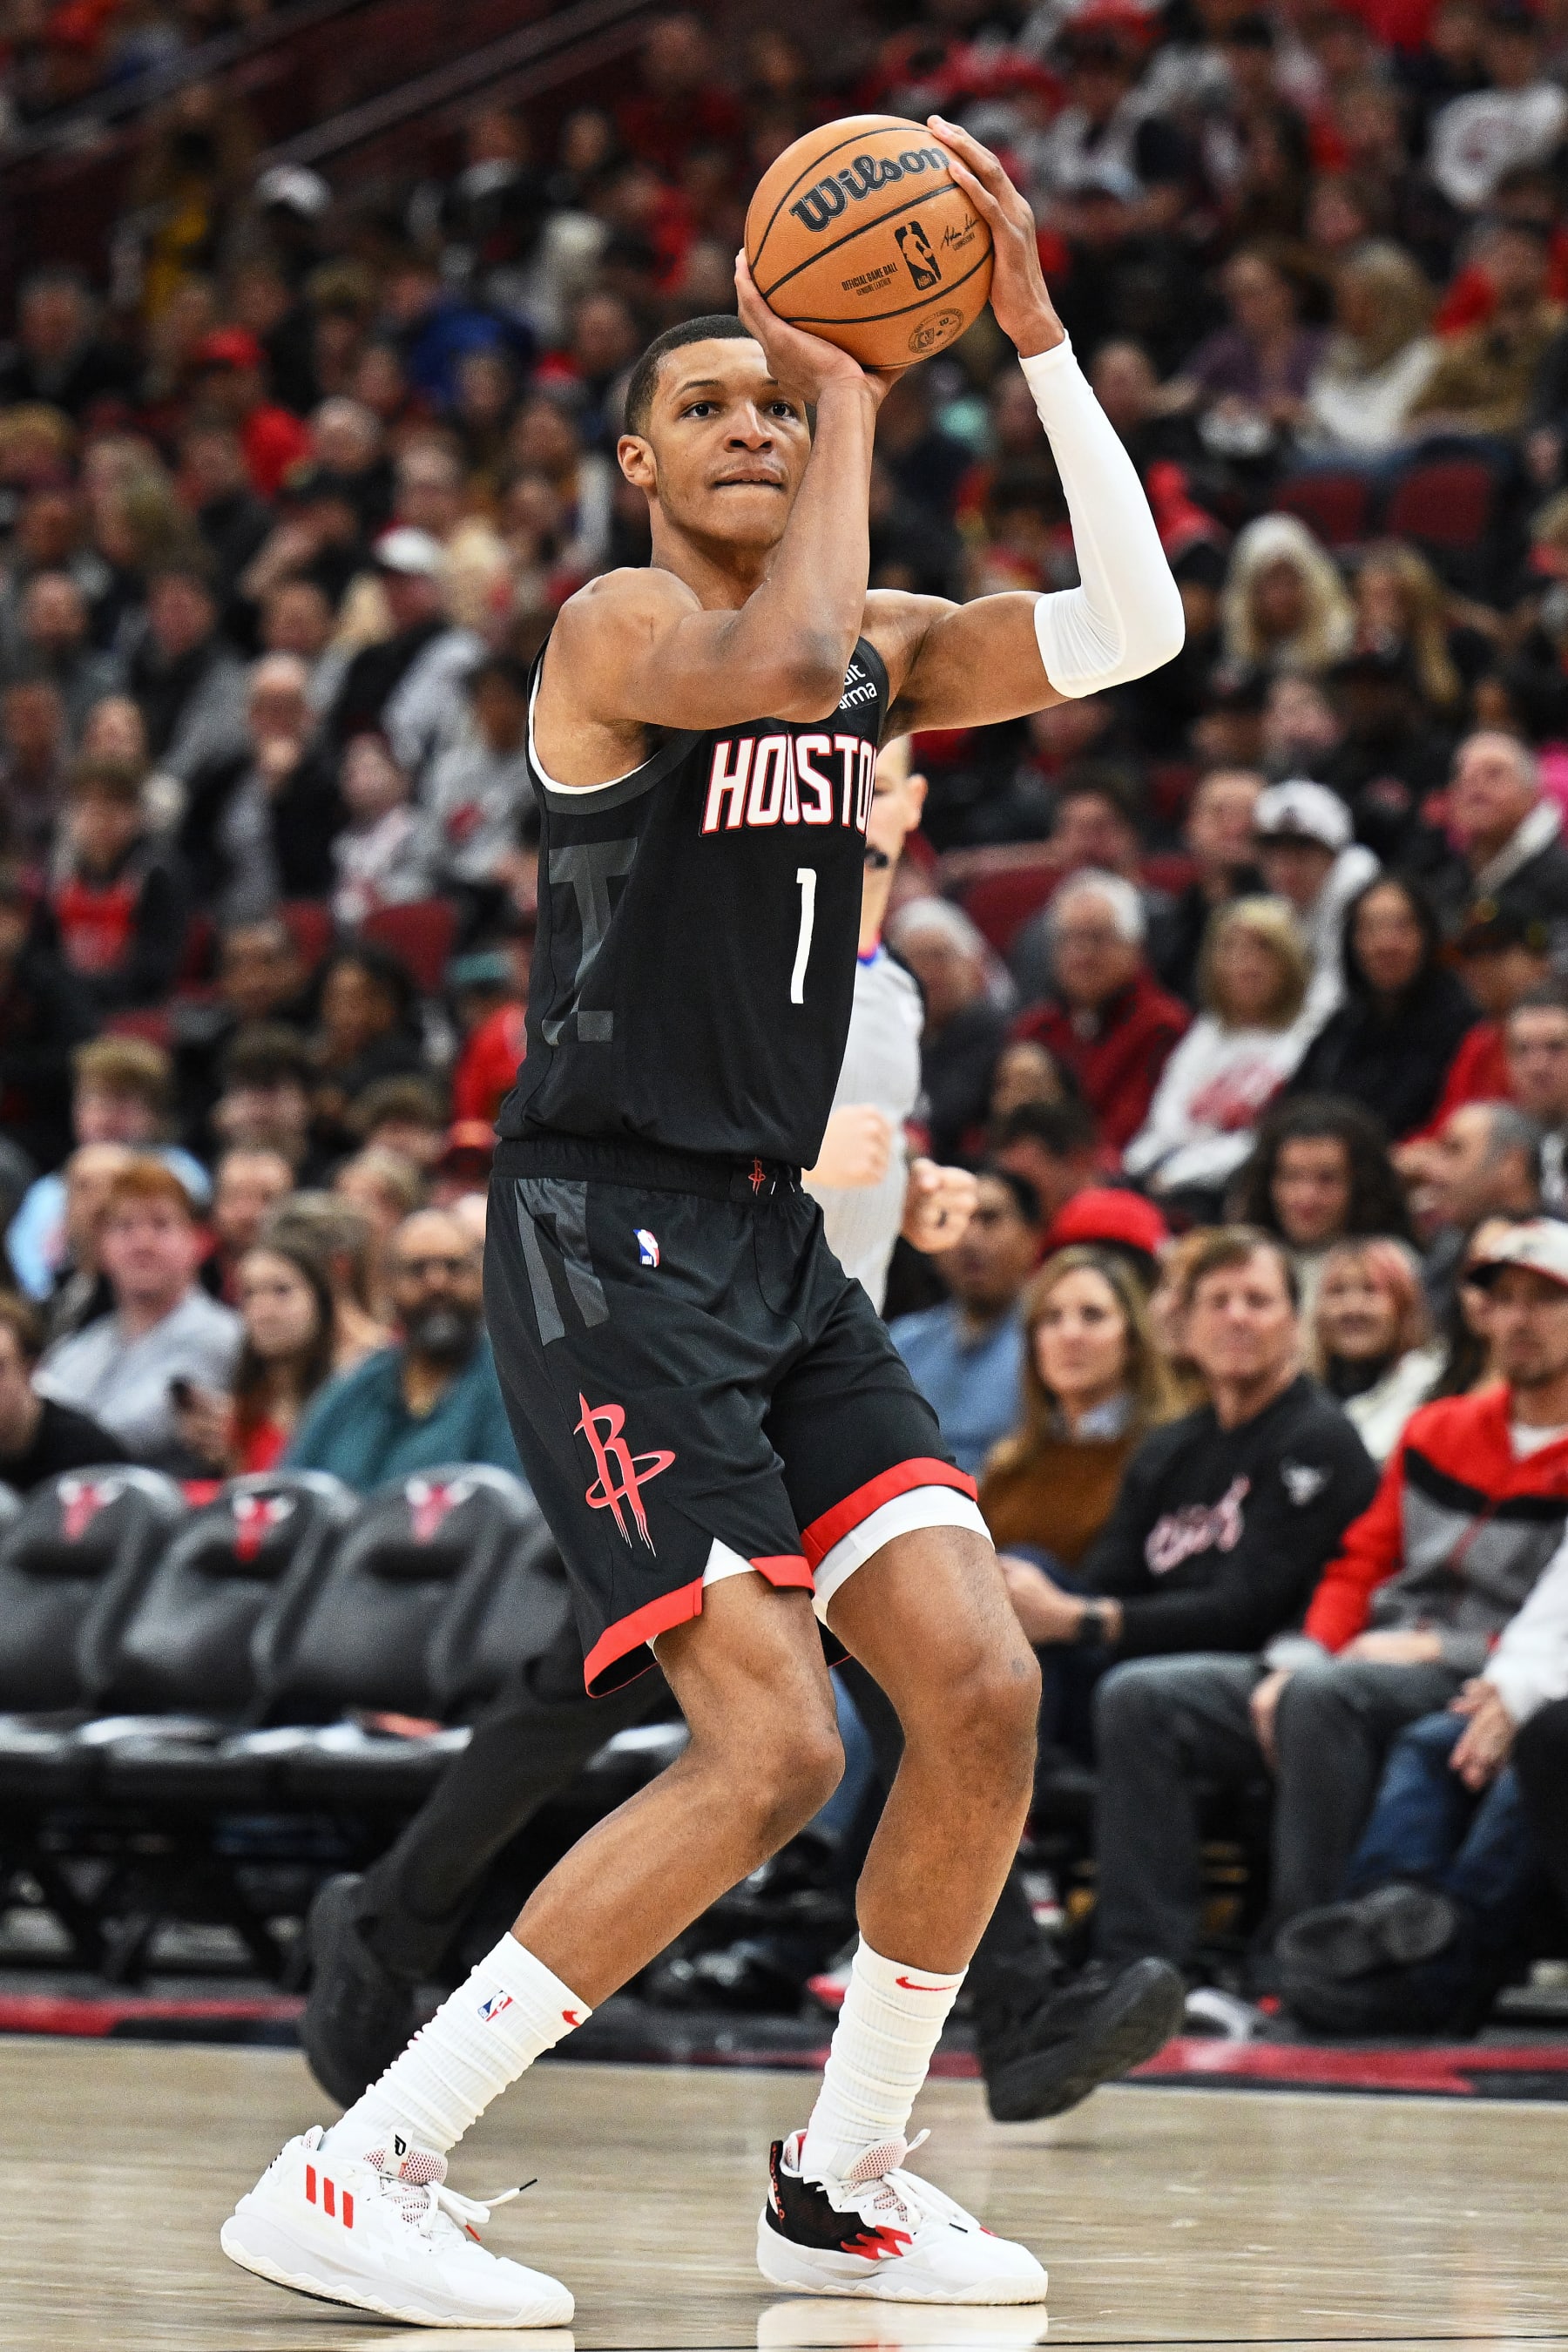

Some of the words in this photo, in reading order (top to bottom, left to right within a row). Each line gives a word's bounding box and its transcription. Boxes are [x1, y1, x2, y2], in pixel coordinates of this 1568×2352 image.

[789, 147, 950, 232] Wilson
[841, 274, 868, 291] OFFICIAL
[866, 268, 884, 282] GAME
[882, 262, 898, 275] BALL
[702, 733, 877, 835] HOUSTO
[790, 868, 817, 1004] 1
